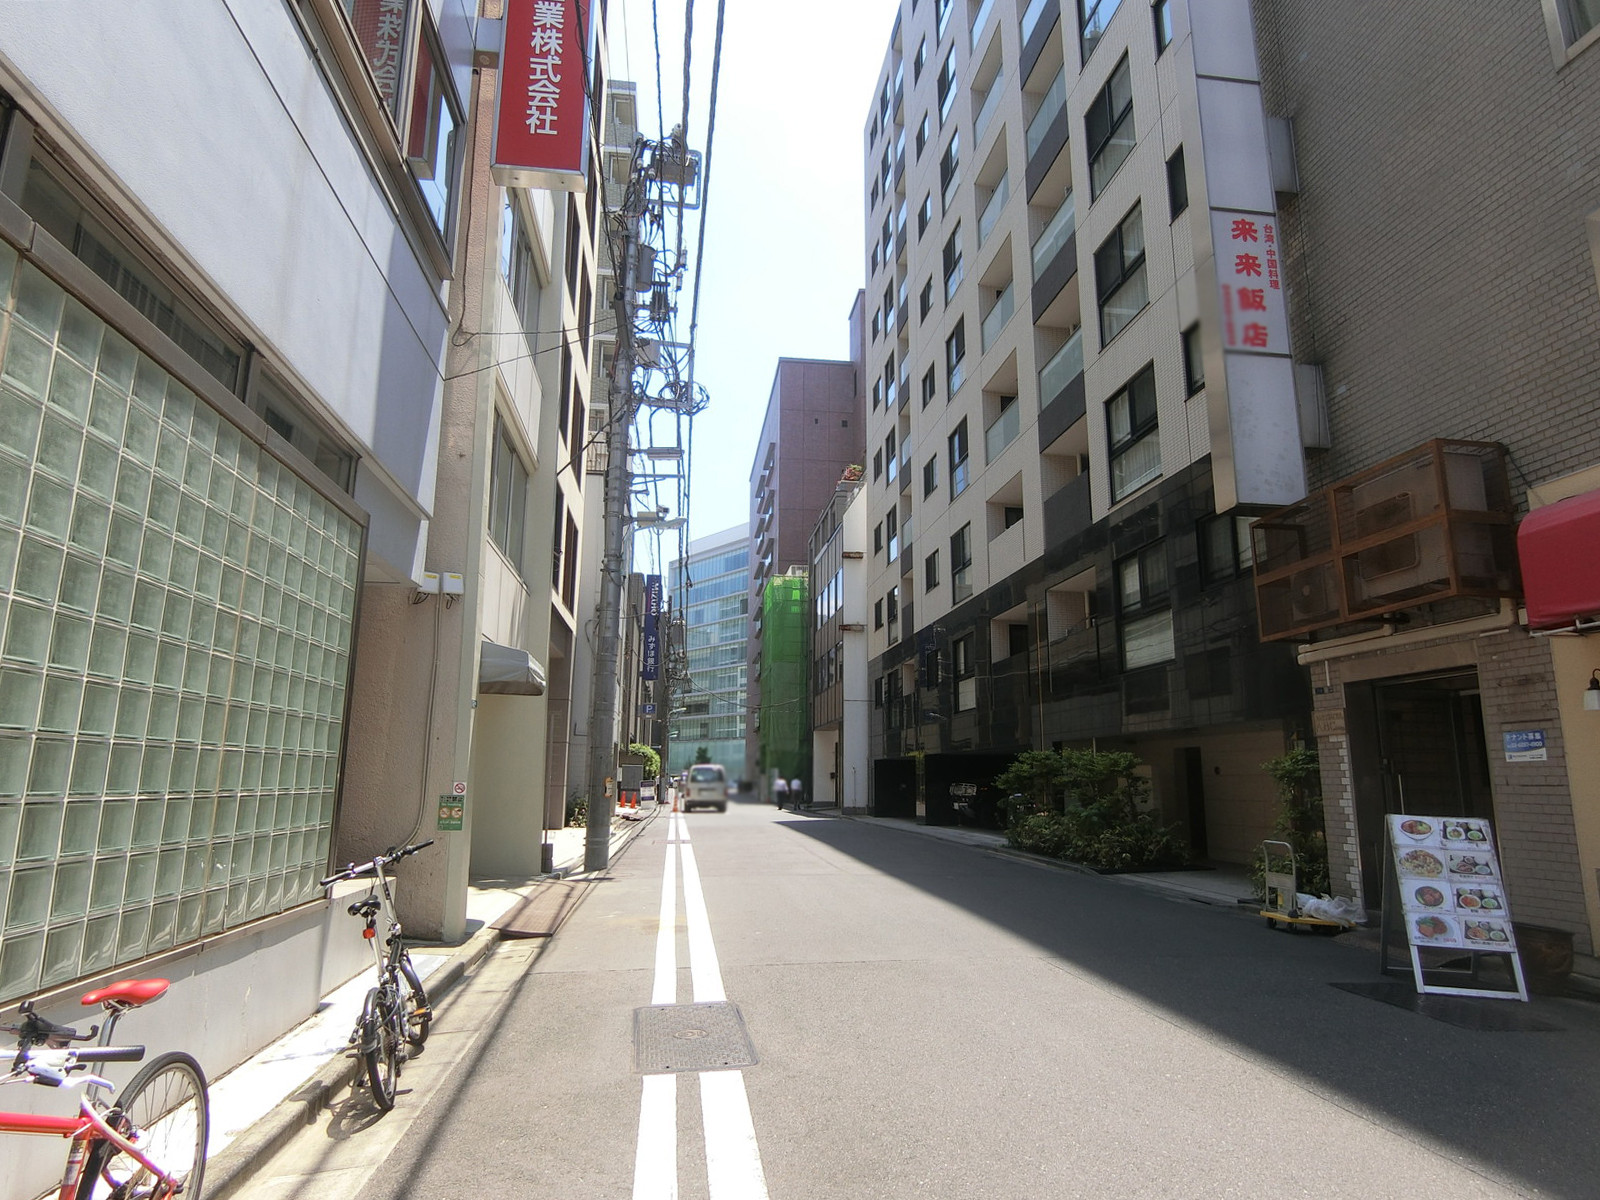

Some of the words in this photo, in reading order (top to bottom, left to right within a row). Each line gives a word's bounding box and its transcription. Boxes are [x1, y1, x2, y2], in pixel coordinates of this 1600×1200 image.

[526, 0, 566, 135] 業株式会社
[1231, 218, 1269, 347] 来来飯店
[649, 582, 659, 616] MIZUHO
[646, 635, 656, 672] みずほ銀行
[646, 704, 653, 713] P
